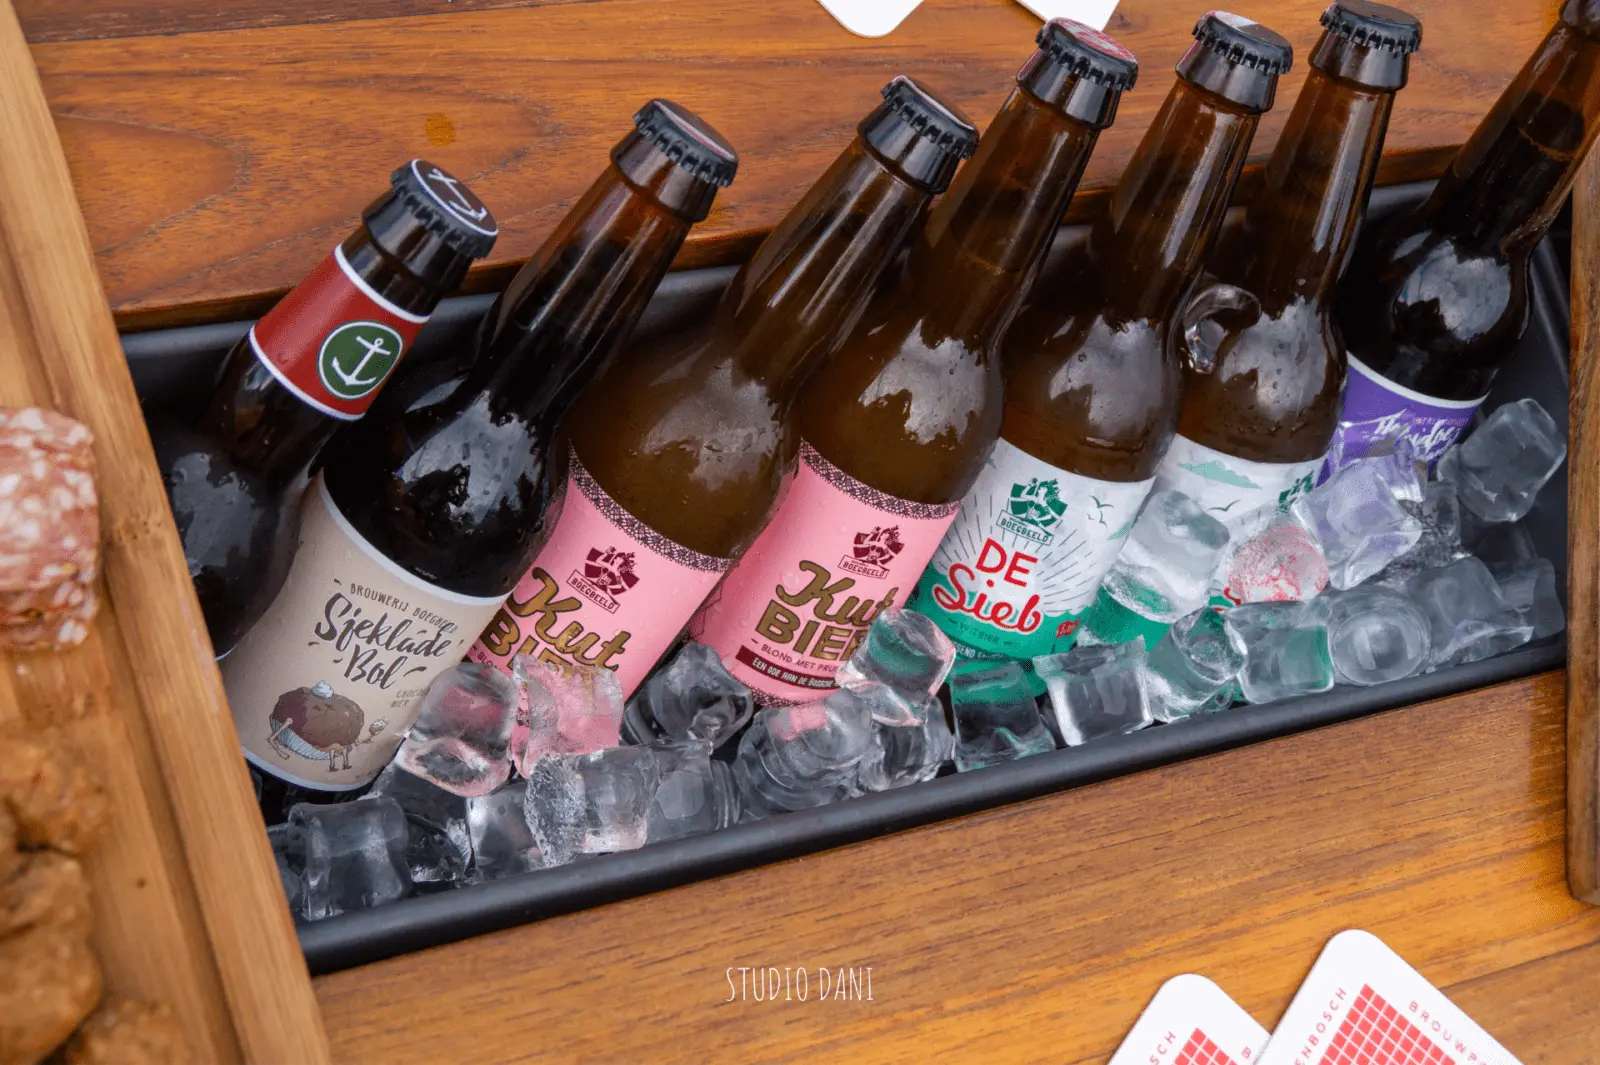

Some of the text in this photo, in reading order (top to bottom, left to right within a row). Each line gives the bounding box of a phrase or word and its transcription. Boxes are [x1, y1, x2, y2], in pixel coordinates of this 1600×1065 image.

[974, 537, 1038, 588] DE
[350, 583, 409, 612] BROUWERIJ
[775, 560, 899, 627] Kut
[932, 562, 1044, 635] Sieb
[505, 566, 632, 672] Kut
[344, 644, 408, 690] Bol
[752, 657, 766, 671] EEN
[767, 665, 781, 677] ODE
[781, 671, 798, 682] AAN
[760, 643, 793, 663] BLOND
[795, 660, 817, 670] MET
